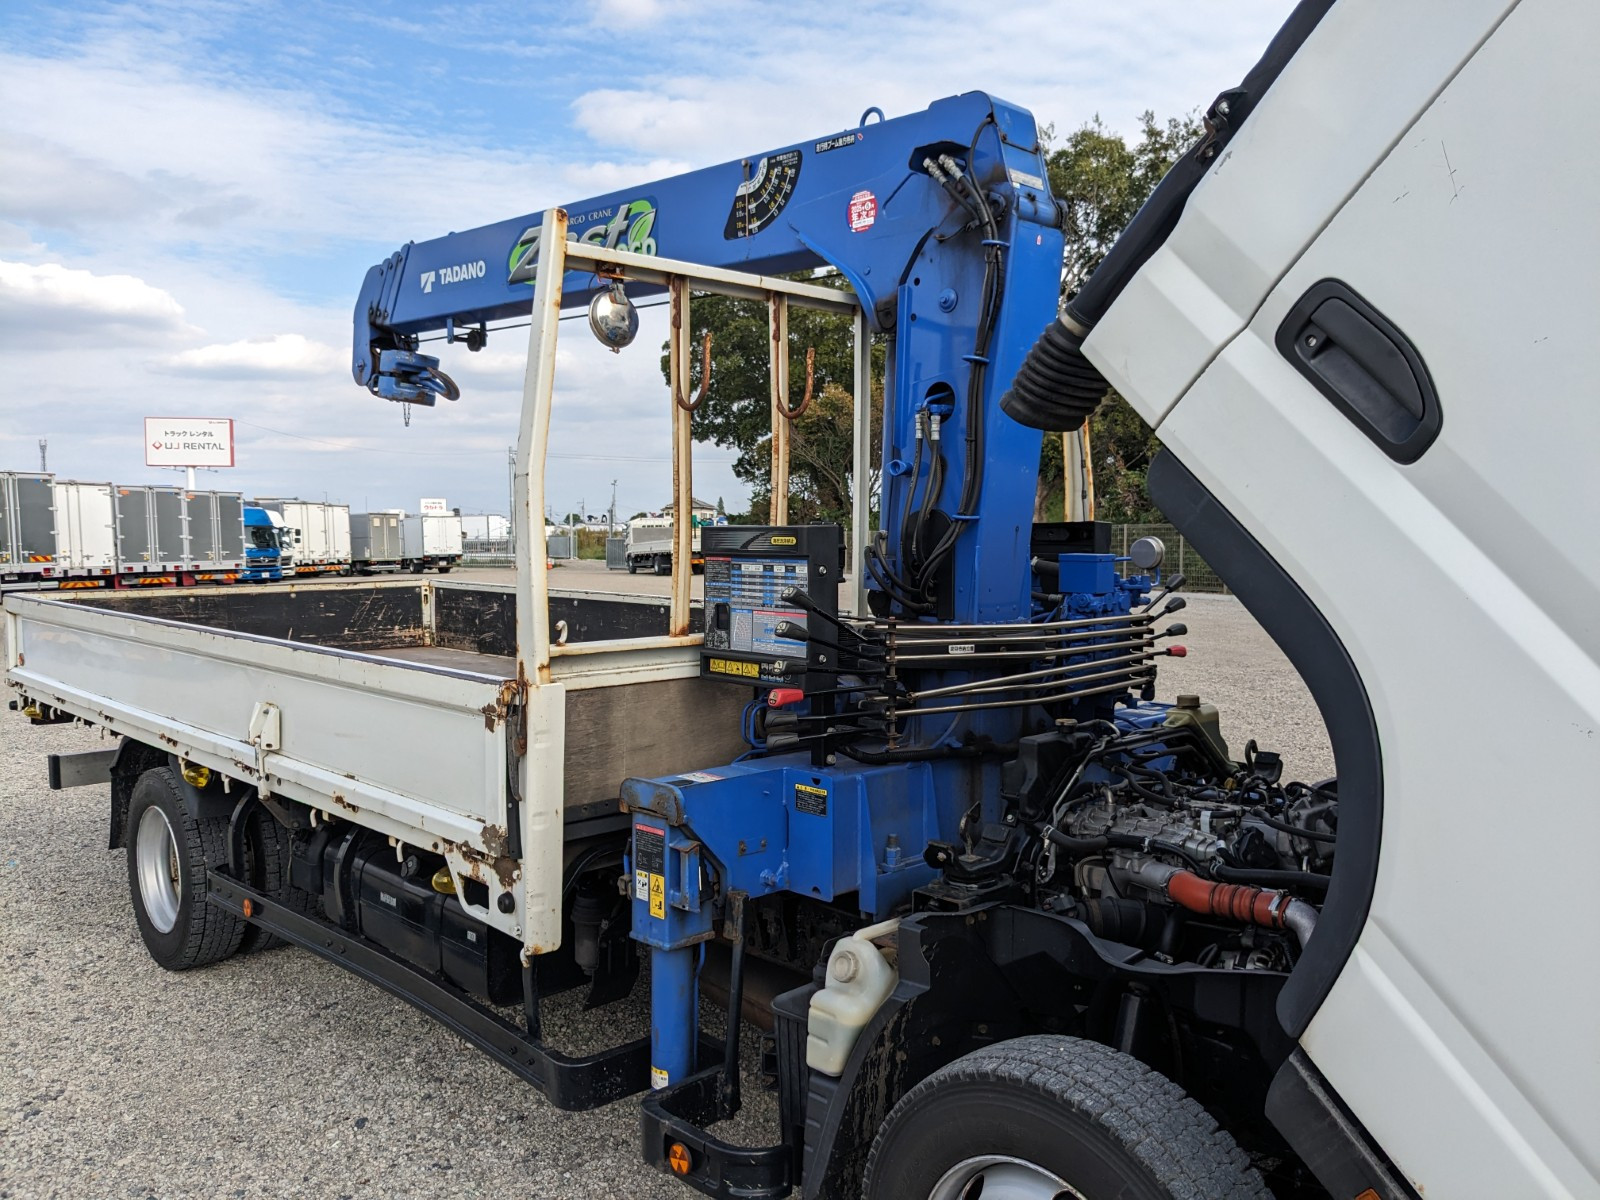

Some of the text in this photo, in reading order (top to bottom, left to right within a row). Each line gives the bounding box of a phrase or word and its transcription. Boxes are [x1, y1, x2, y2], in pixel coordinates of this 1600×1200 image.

[566, 208, 612, 226] ARGO CRANE
[439, 260, 486, 285] TADANO
[183, 442, 225, 450] RENTAL
